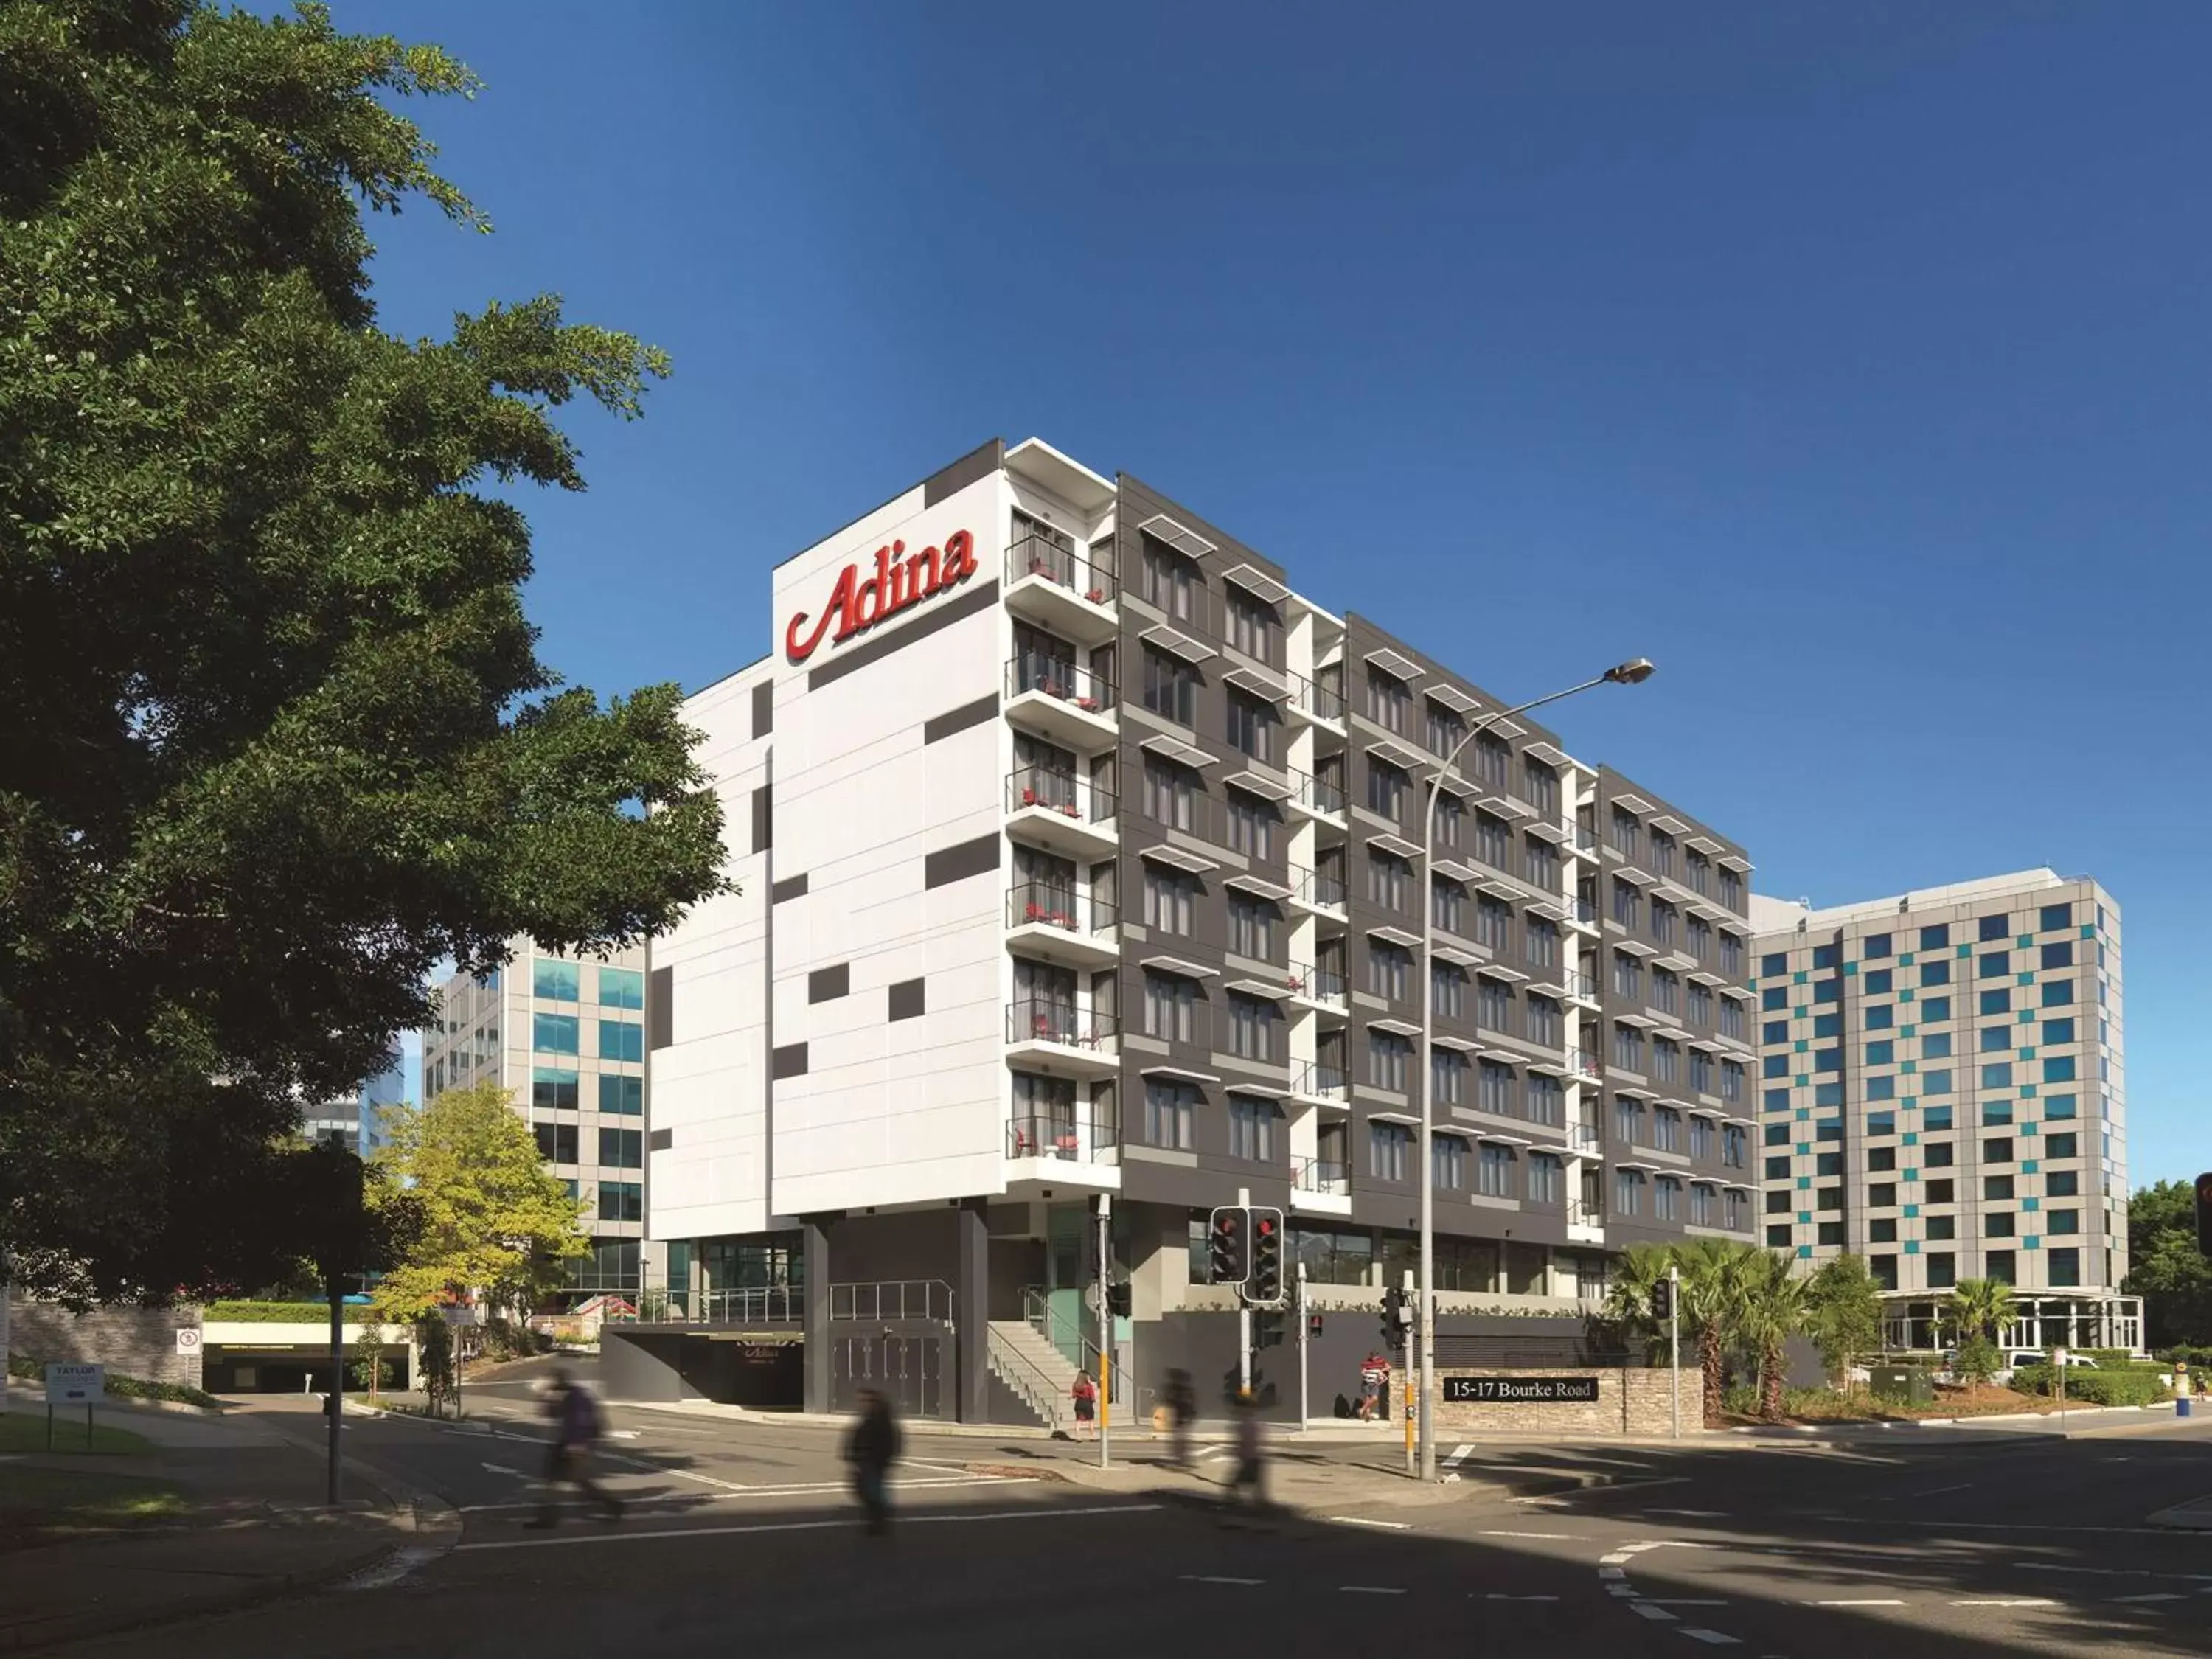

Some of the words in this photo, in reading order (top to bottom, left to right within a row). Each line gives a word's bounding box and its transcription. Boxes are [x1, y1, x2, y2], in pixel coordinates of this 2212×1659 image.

[786, 529, 978, 659] Adina
[1453, 1382, 1494, 1397] 15-17
[1498, 1382, 1552, 1397] Bourke
[1556, 1382, 1591, 1397] Road
